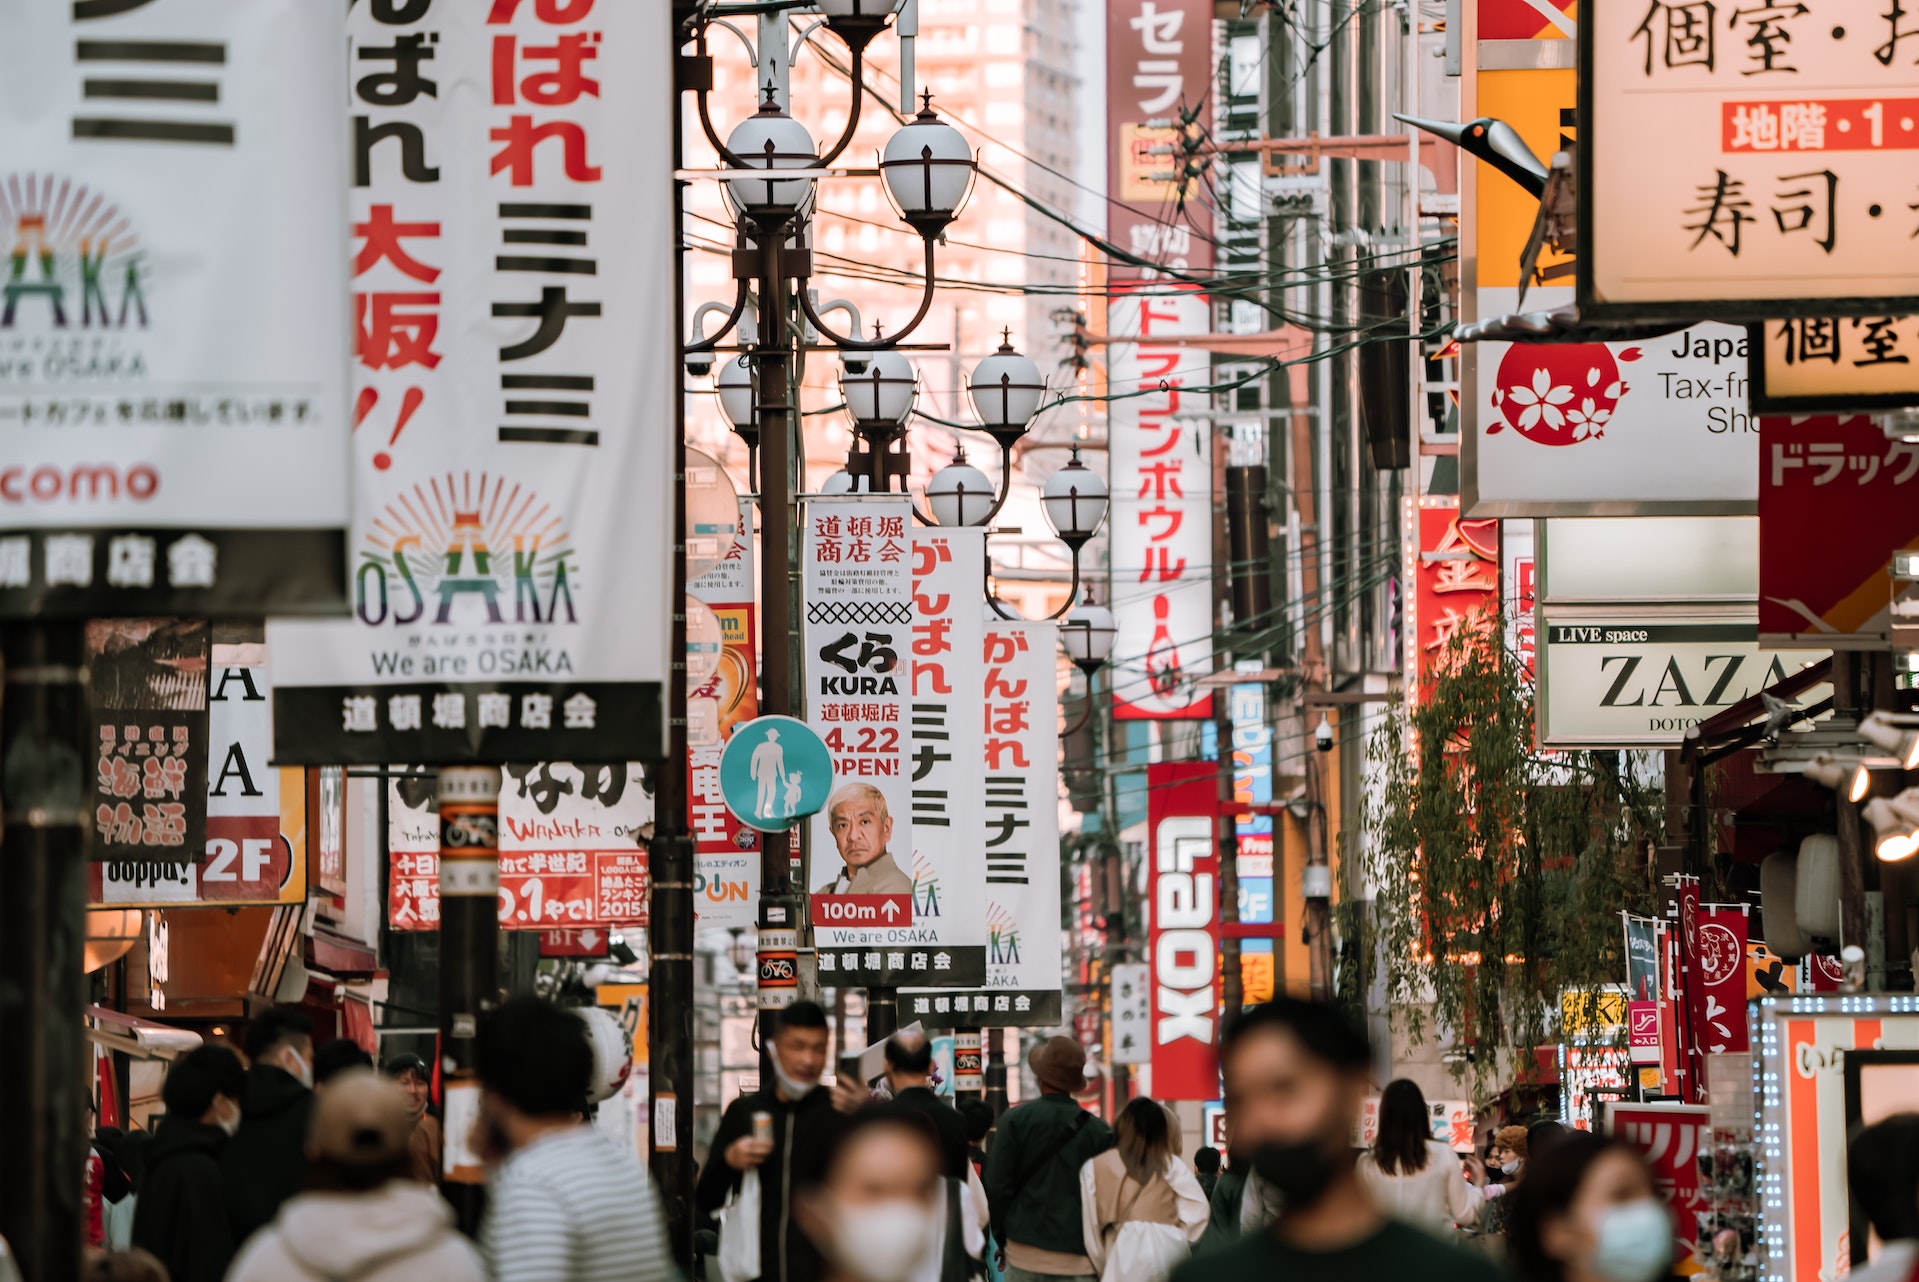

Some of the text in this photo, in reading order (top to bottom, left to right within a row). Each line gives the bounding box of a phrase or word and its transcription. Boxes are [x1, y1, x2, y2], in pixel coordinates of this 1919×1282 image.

[815, 515, 905, 539] 道頓堀
[816, 539, 906, 563] 商店会
[1559, 627, 1648, 644] LIVE space
[820, 631, 898, 673] くら
[371, 650, 574, 676] We are OSAKA
[820, 677, 898, 695] KURA
[342, 692, 597, 731] 道頓堀商店会
[820, 704, 899, 722] 道頓堀店
[824, 727, 899, 753] 4.22
[202, 838, 272, 881] 2F
[821, 903, 876, 919] 100m
[833, 930, 939, 943] We are OSAKA
[818, 952, 951, 971] 道頓堀商店会
[914, 995, 1031, 1014] 道頓堀商店会
